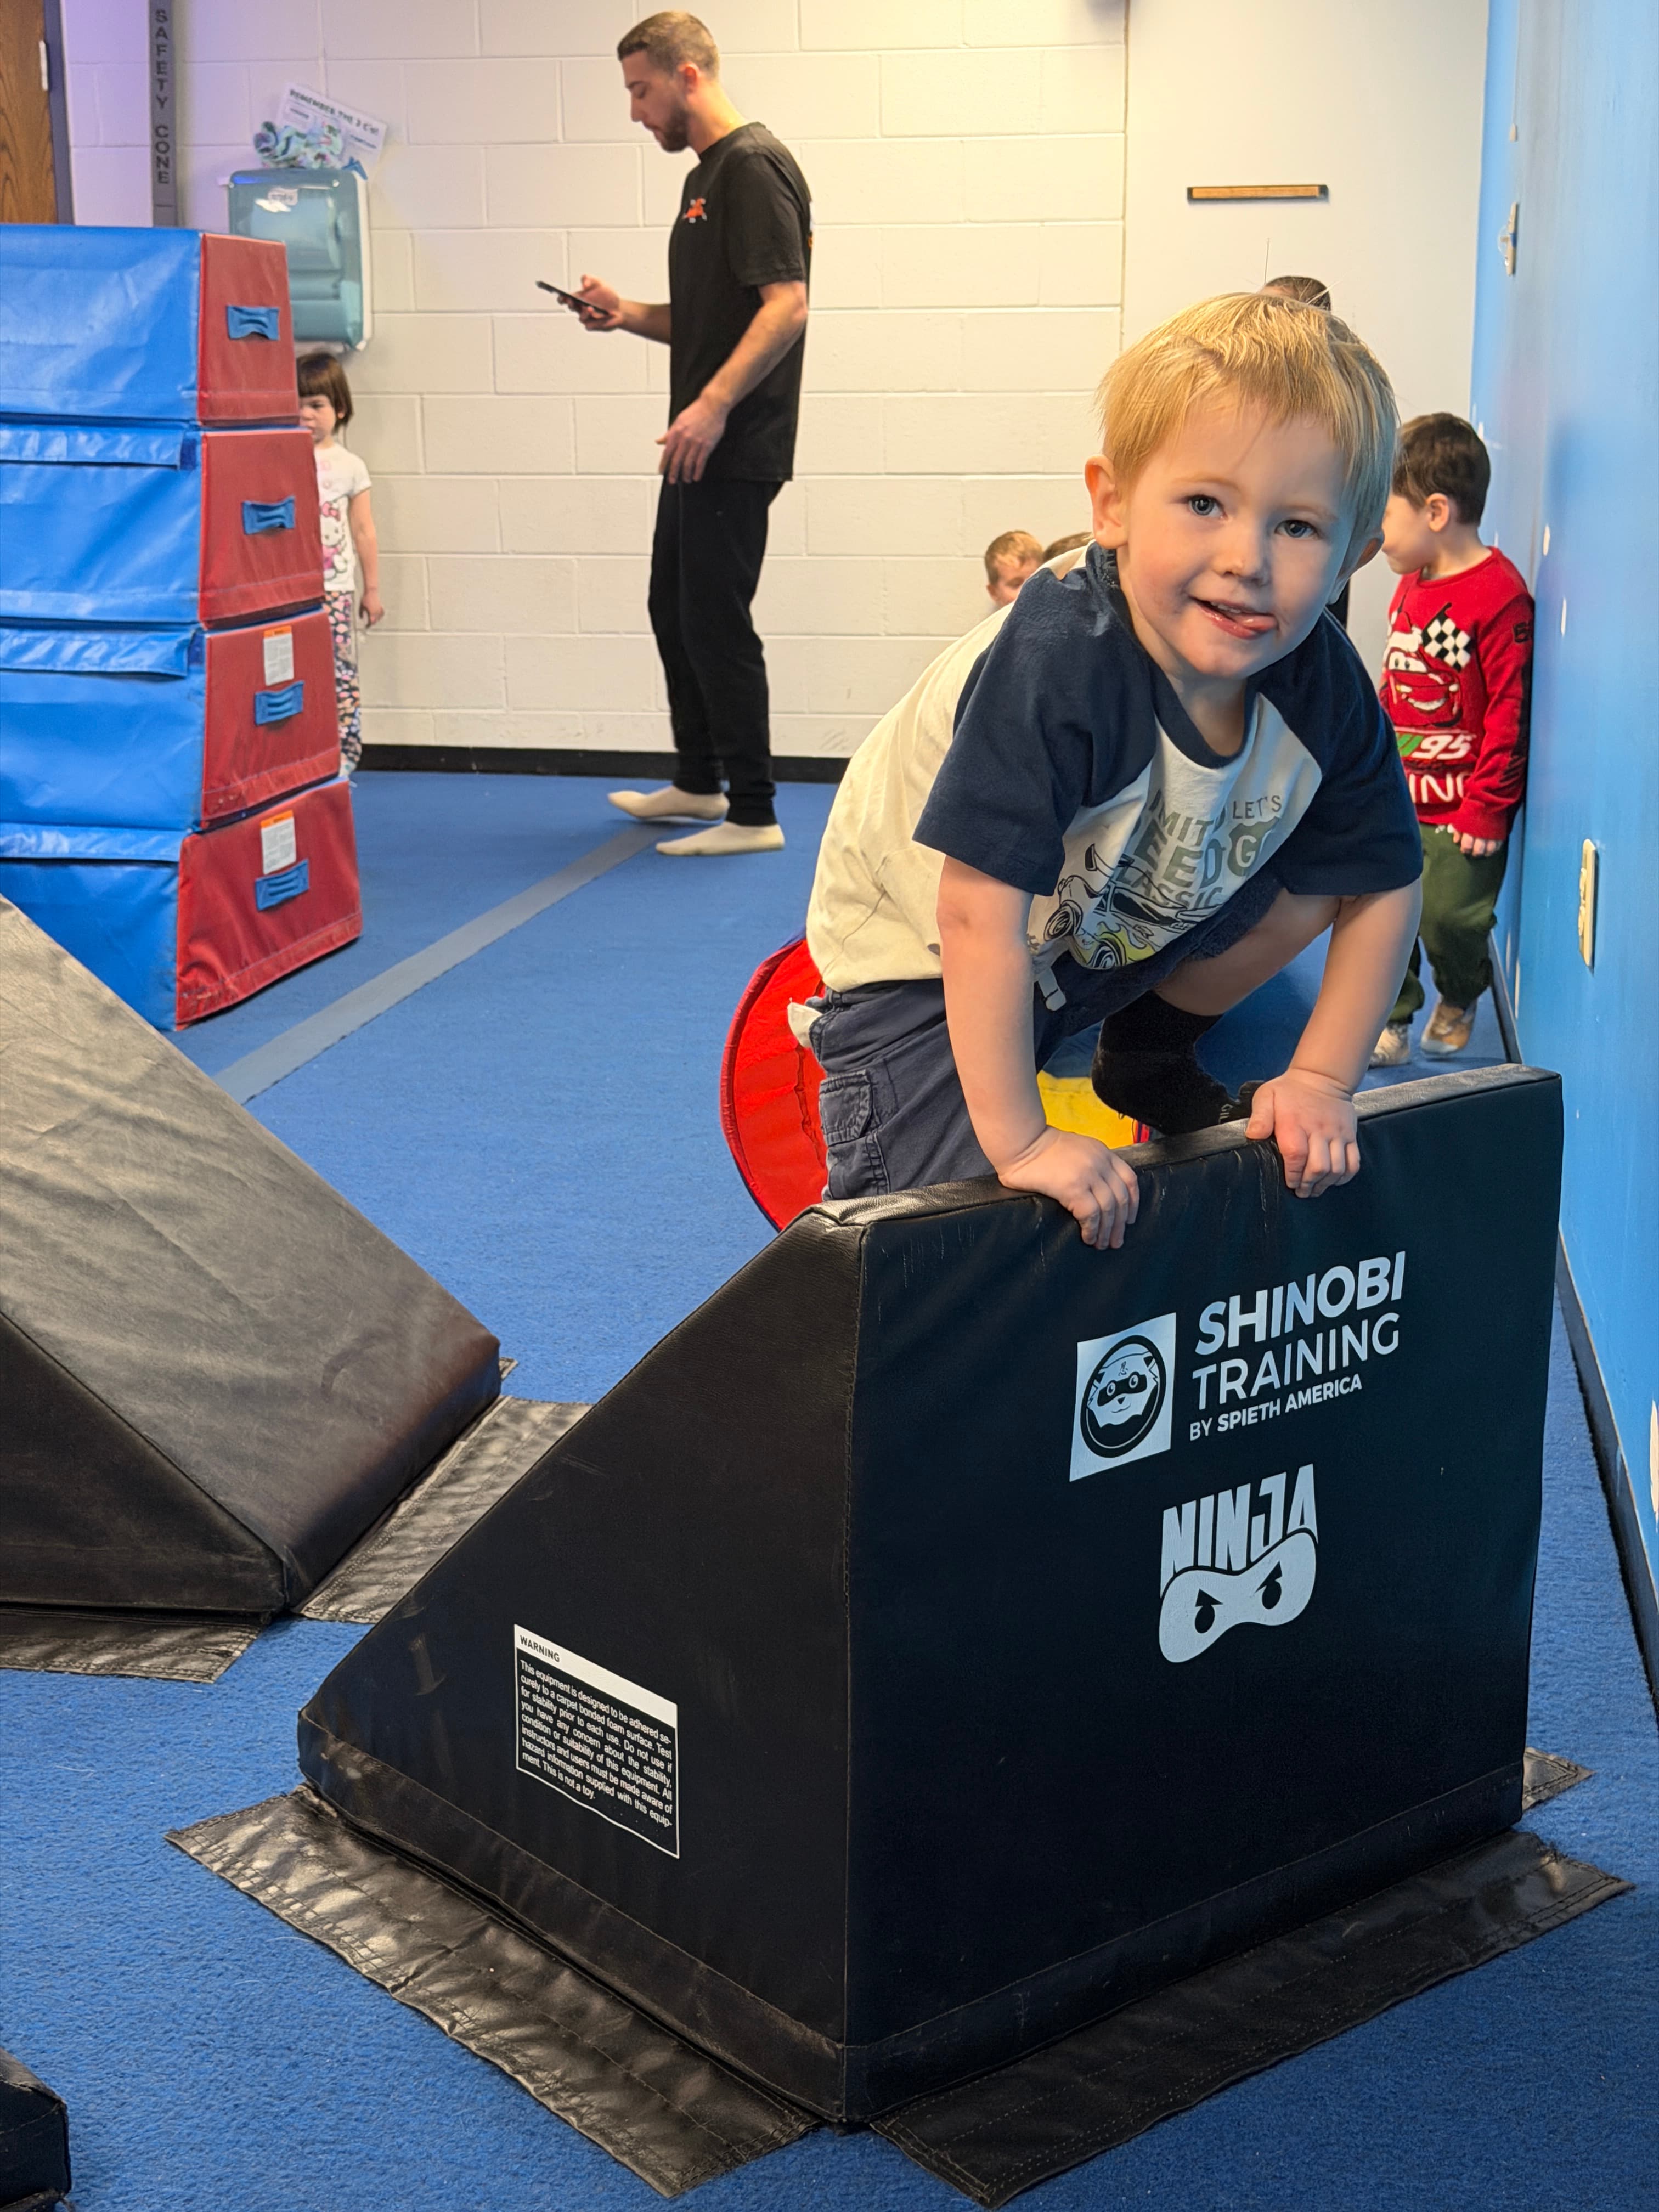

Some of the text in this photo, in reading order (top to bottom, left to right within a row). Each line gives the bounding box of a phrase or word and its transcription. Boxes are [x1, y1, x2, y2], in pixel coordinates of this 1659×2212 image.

[155, 9, 170, 184] SAFETY CONE
[1411, 734, 1473, 760] 95
[1232, 795, 1282, 819] LET'S
[1195, 1251, 1405, 1355] SHINOBI
[1192, 1313, 1400, 1410] TRAINING
[1190, 1374, 1362, 1441] BY SPIETH AMERICA
[1160, 1464, 1318, 1597] NINJA
[520, 1635, 559, 1662] WARNING
[520, 1659, 672, 1744] This equipment is designed to be adhered se-
[520, 1675, 672, 1759] curely to a carpet bonded foam surface. Test
[521, 1685, 672, 1773] for stability prior to each use. Do not use if
[521, 1700, 533, 1713] you
[537, 1707, 553, 1723] have
[556, 1719, 569, 1734] any
[604, 1745, 624, 1761] about
[628, 1755, 639, 1769] the
[643, 1765, 672, 1788] stability,
[521, 1713, 551, 1735] condition
[552, 1730, 560, 1740] or
[562, 1736, 594, 1760] suitability
[596, 1754, 603, 1763] of
[606, 1757, 618, 1771] this
[662, 1787, 672, 1801] All
[522, 1724, 672, 1814] instructors and users must be made aware of
[522, 1752, 595, 1800] ment. This is not a toy.
[522, 1737, 672, 1827] hazard information supplied with this equip-
